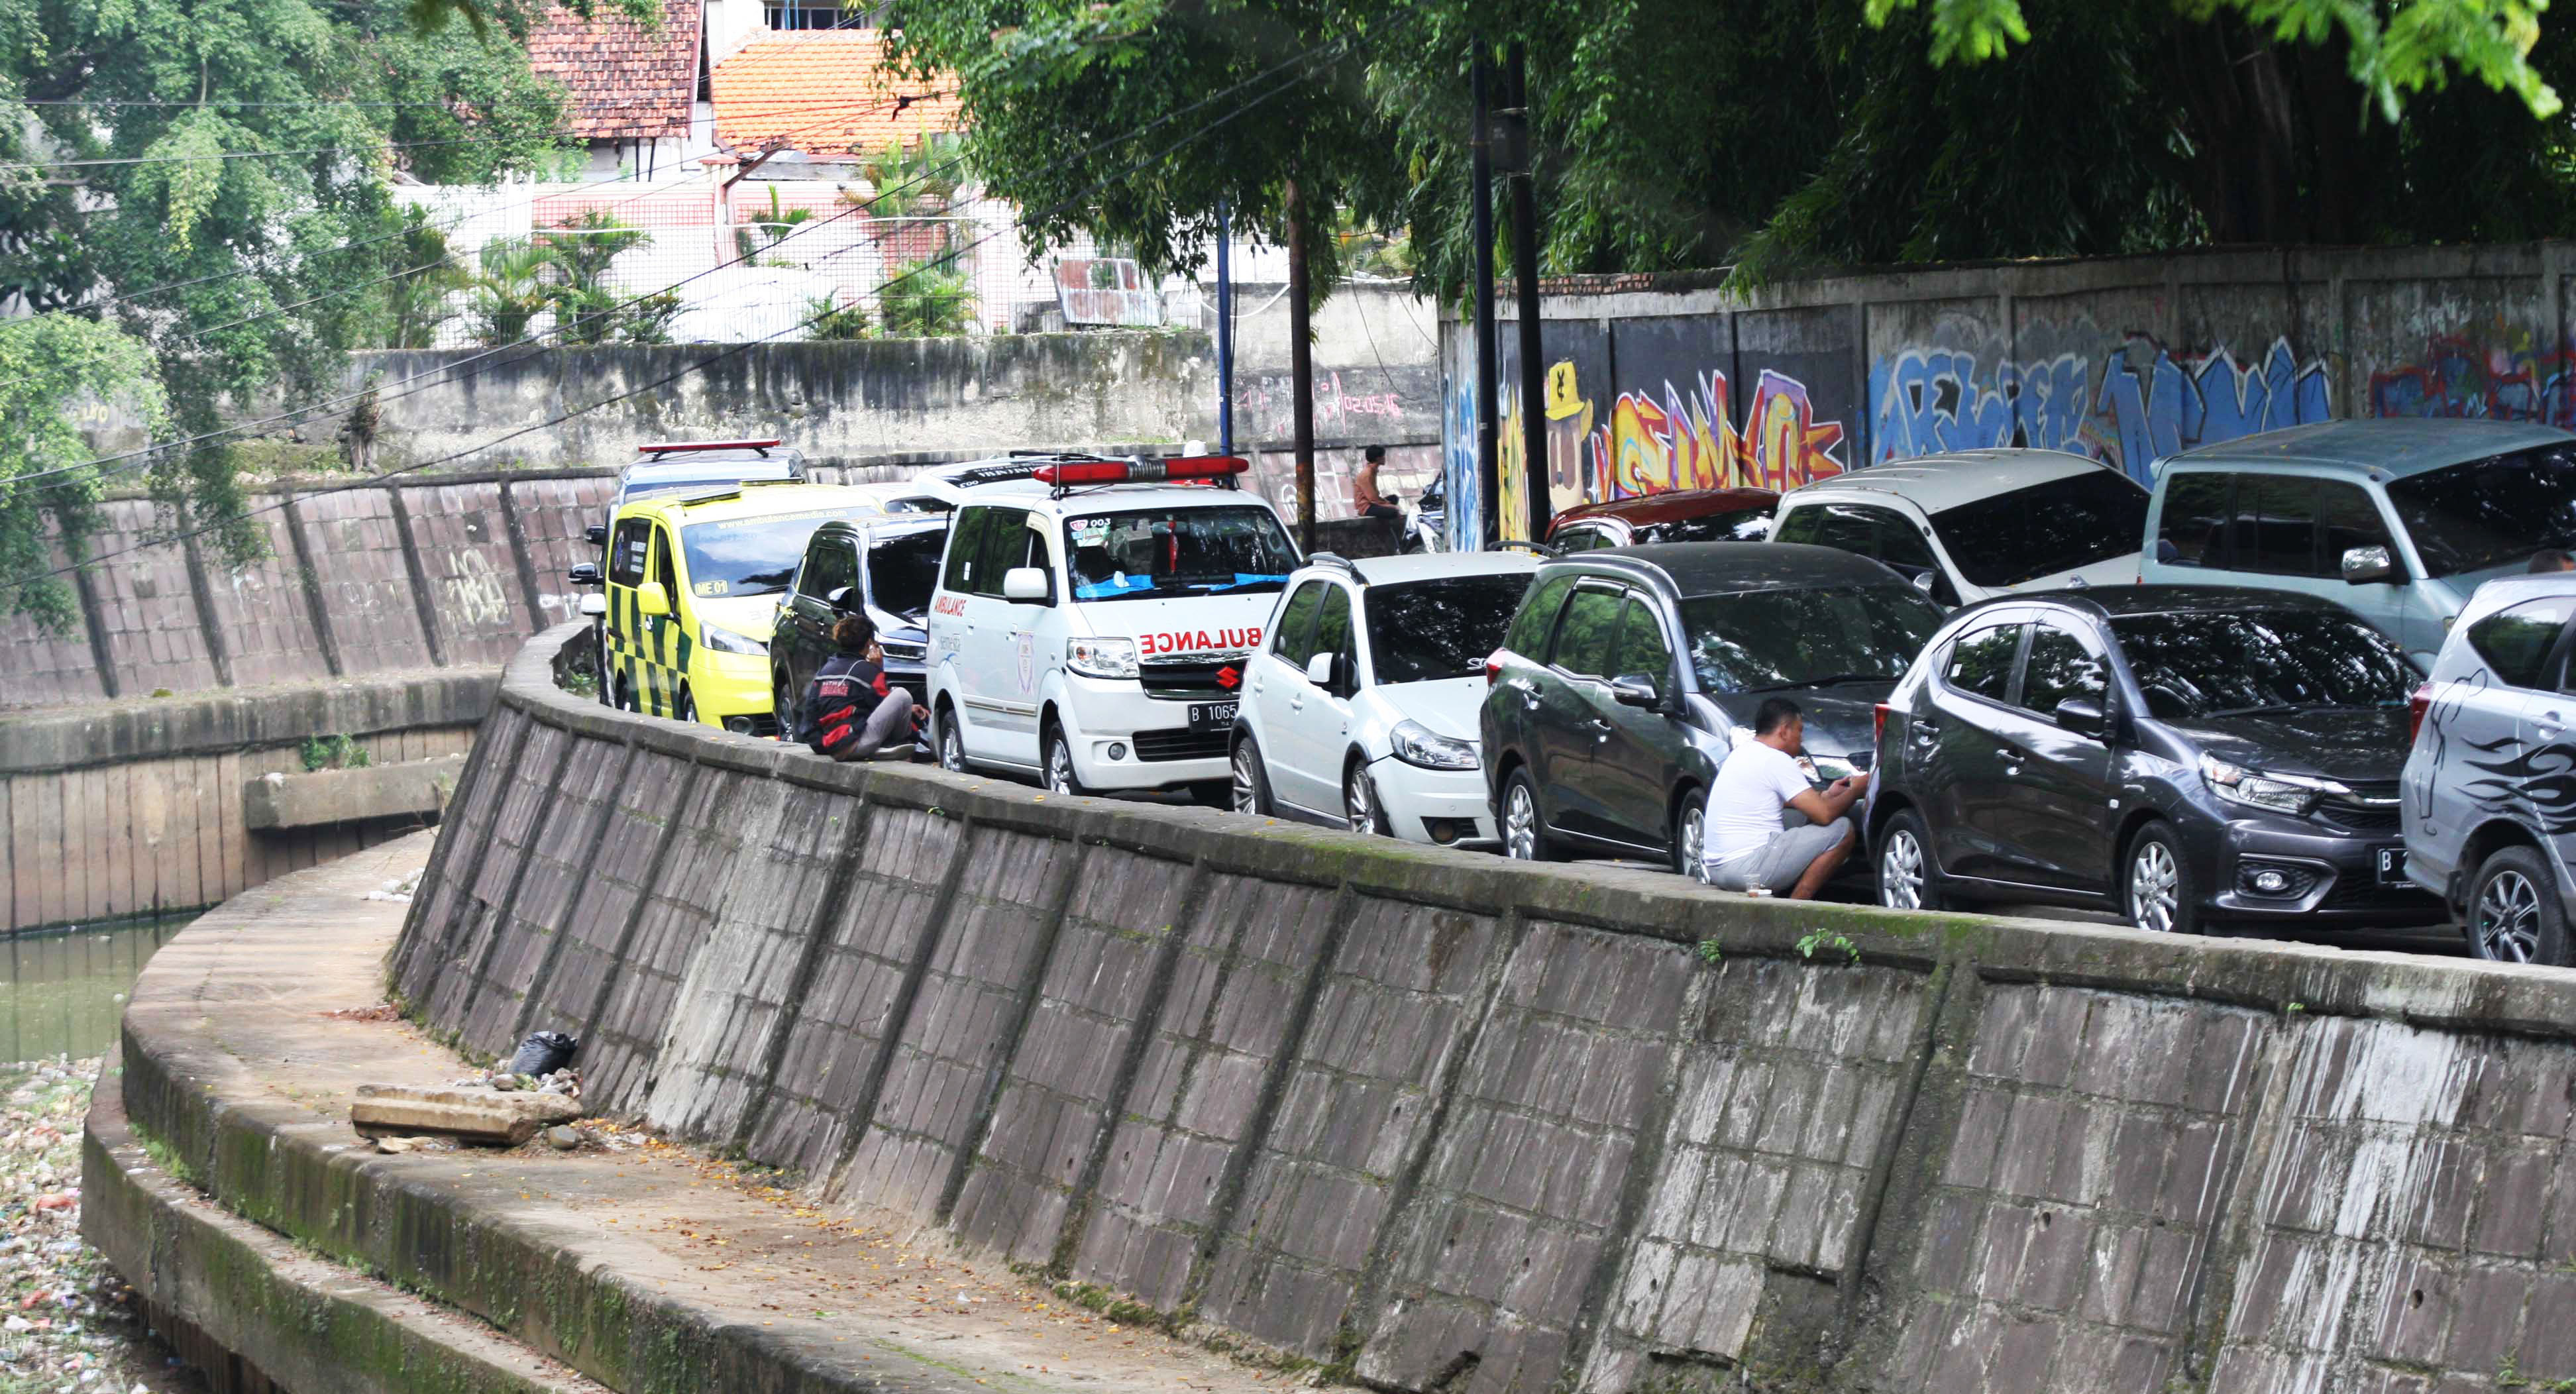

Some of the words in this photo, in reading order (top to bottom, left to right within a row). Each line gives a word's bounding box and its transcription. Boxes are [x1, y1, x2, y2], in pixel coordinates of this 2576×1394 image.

[717, 509, 848, 529] www.ambulancemedia.com
[1090, 517, 1111, 527] 003
[698, 583, 713, 594] ME
[714, 582, 725, 594] 01
[1191, 706, 1200, 722] B
[1208, 704, 1238, 720] 1065
[2381, 851, 2392, 872] B
